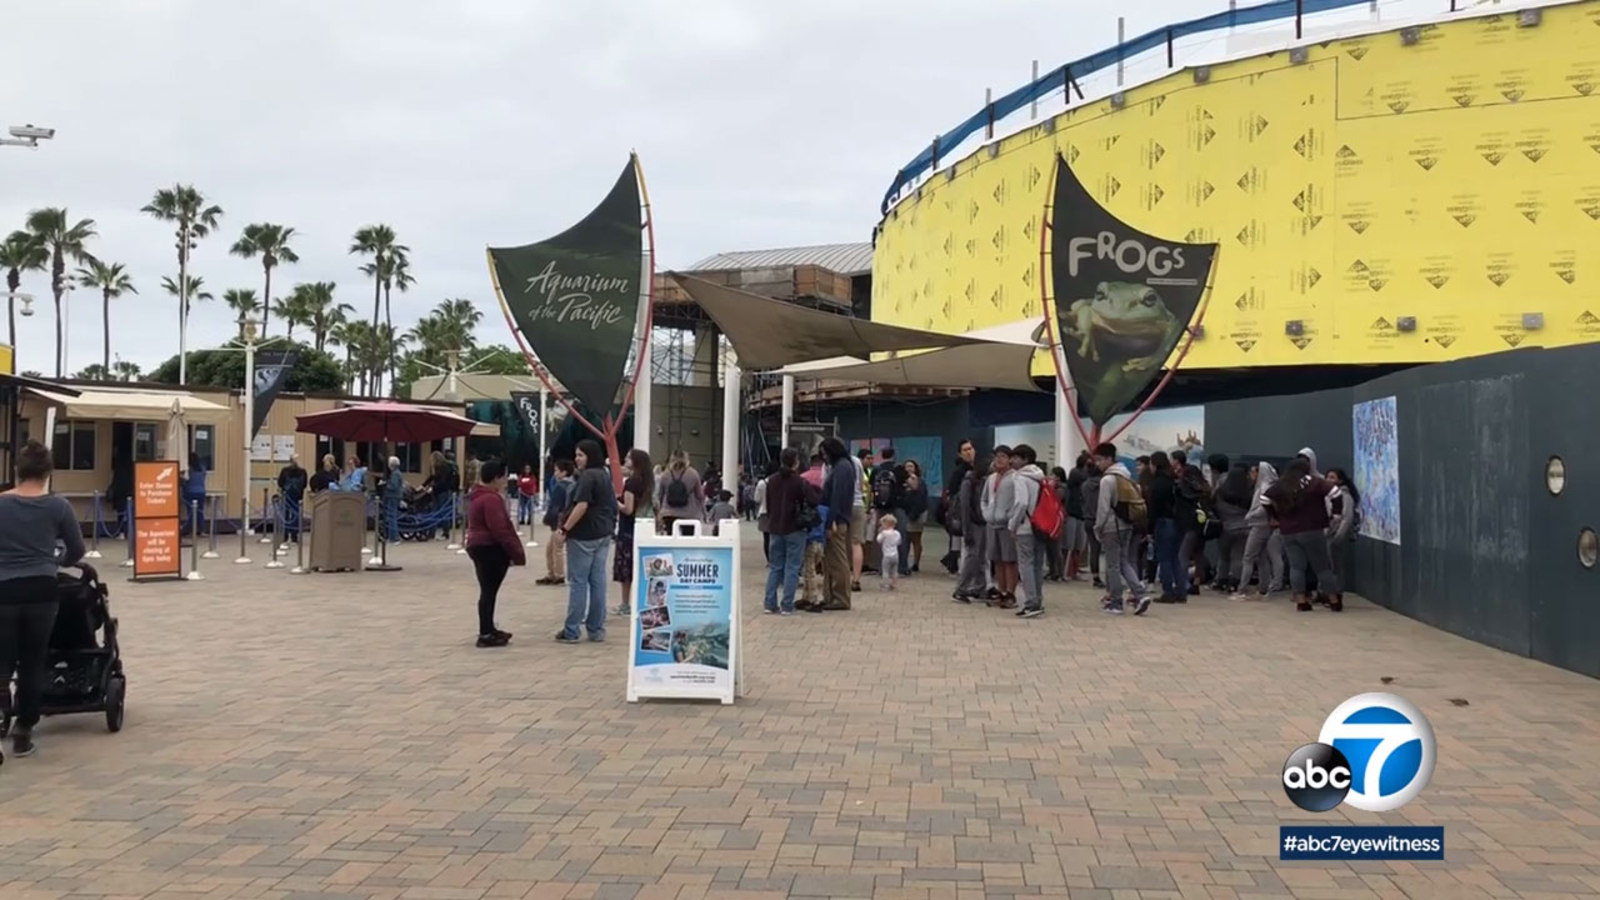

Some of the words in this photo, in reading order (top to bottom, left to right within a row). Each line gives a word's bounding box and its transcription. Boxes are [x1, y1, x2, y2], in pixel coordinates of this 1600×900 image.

[1069, 231, 1185, 277] FROGS
[524, 260, 629, 305] Aquarium
[528, 304, 543, 321] of
[540, 304, 557, 319] the
[557, 292, 625, 330] Pacific
[676, 563, 719, 578] SUMMER
